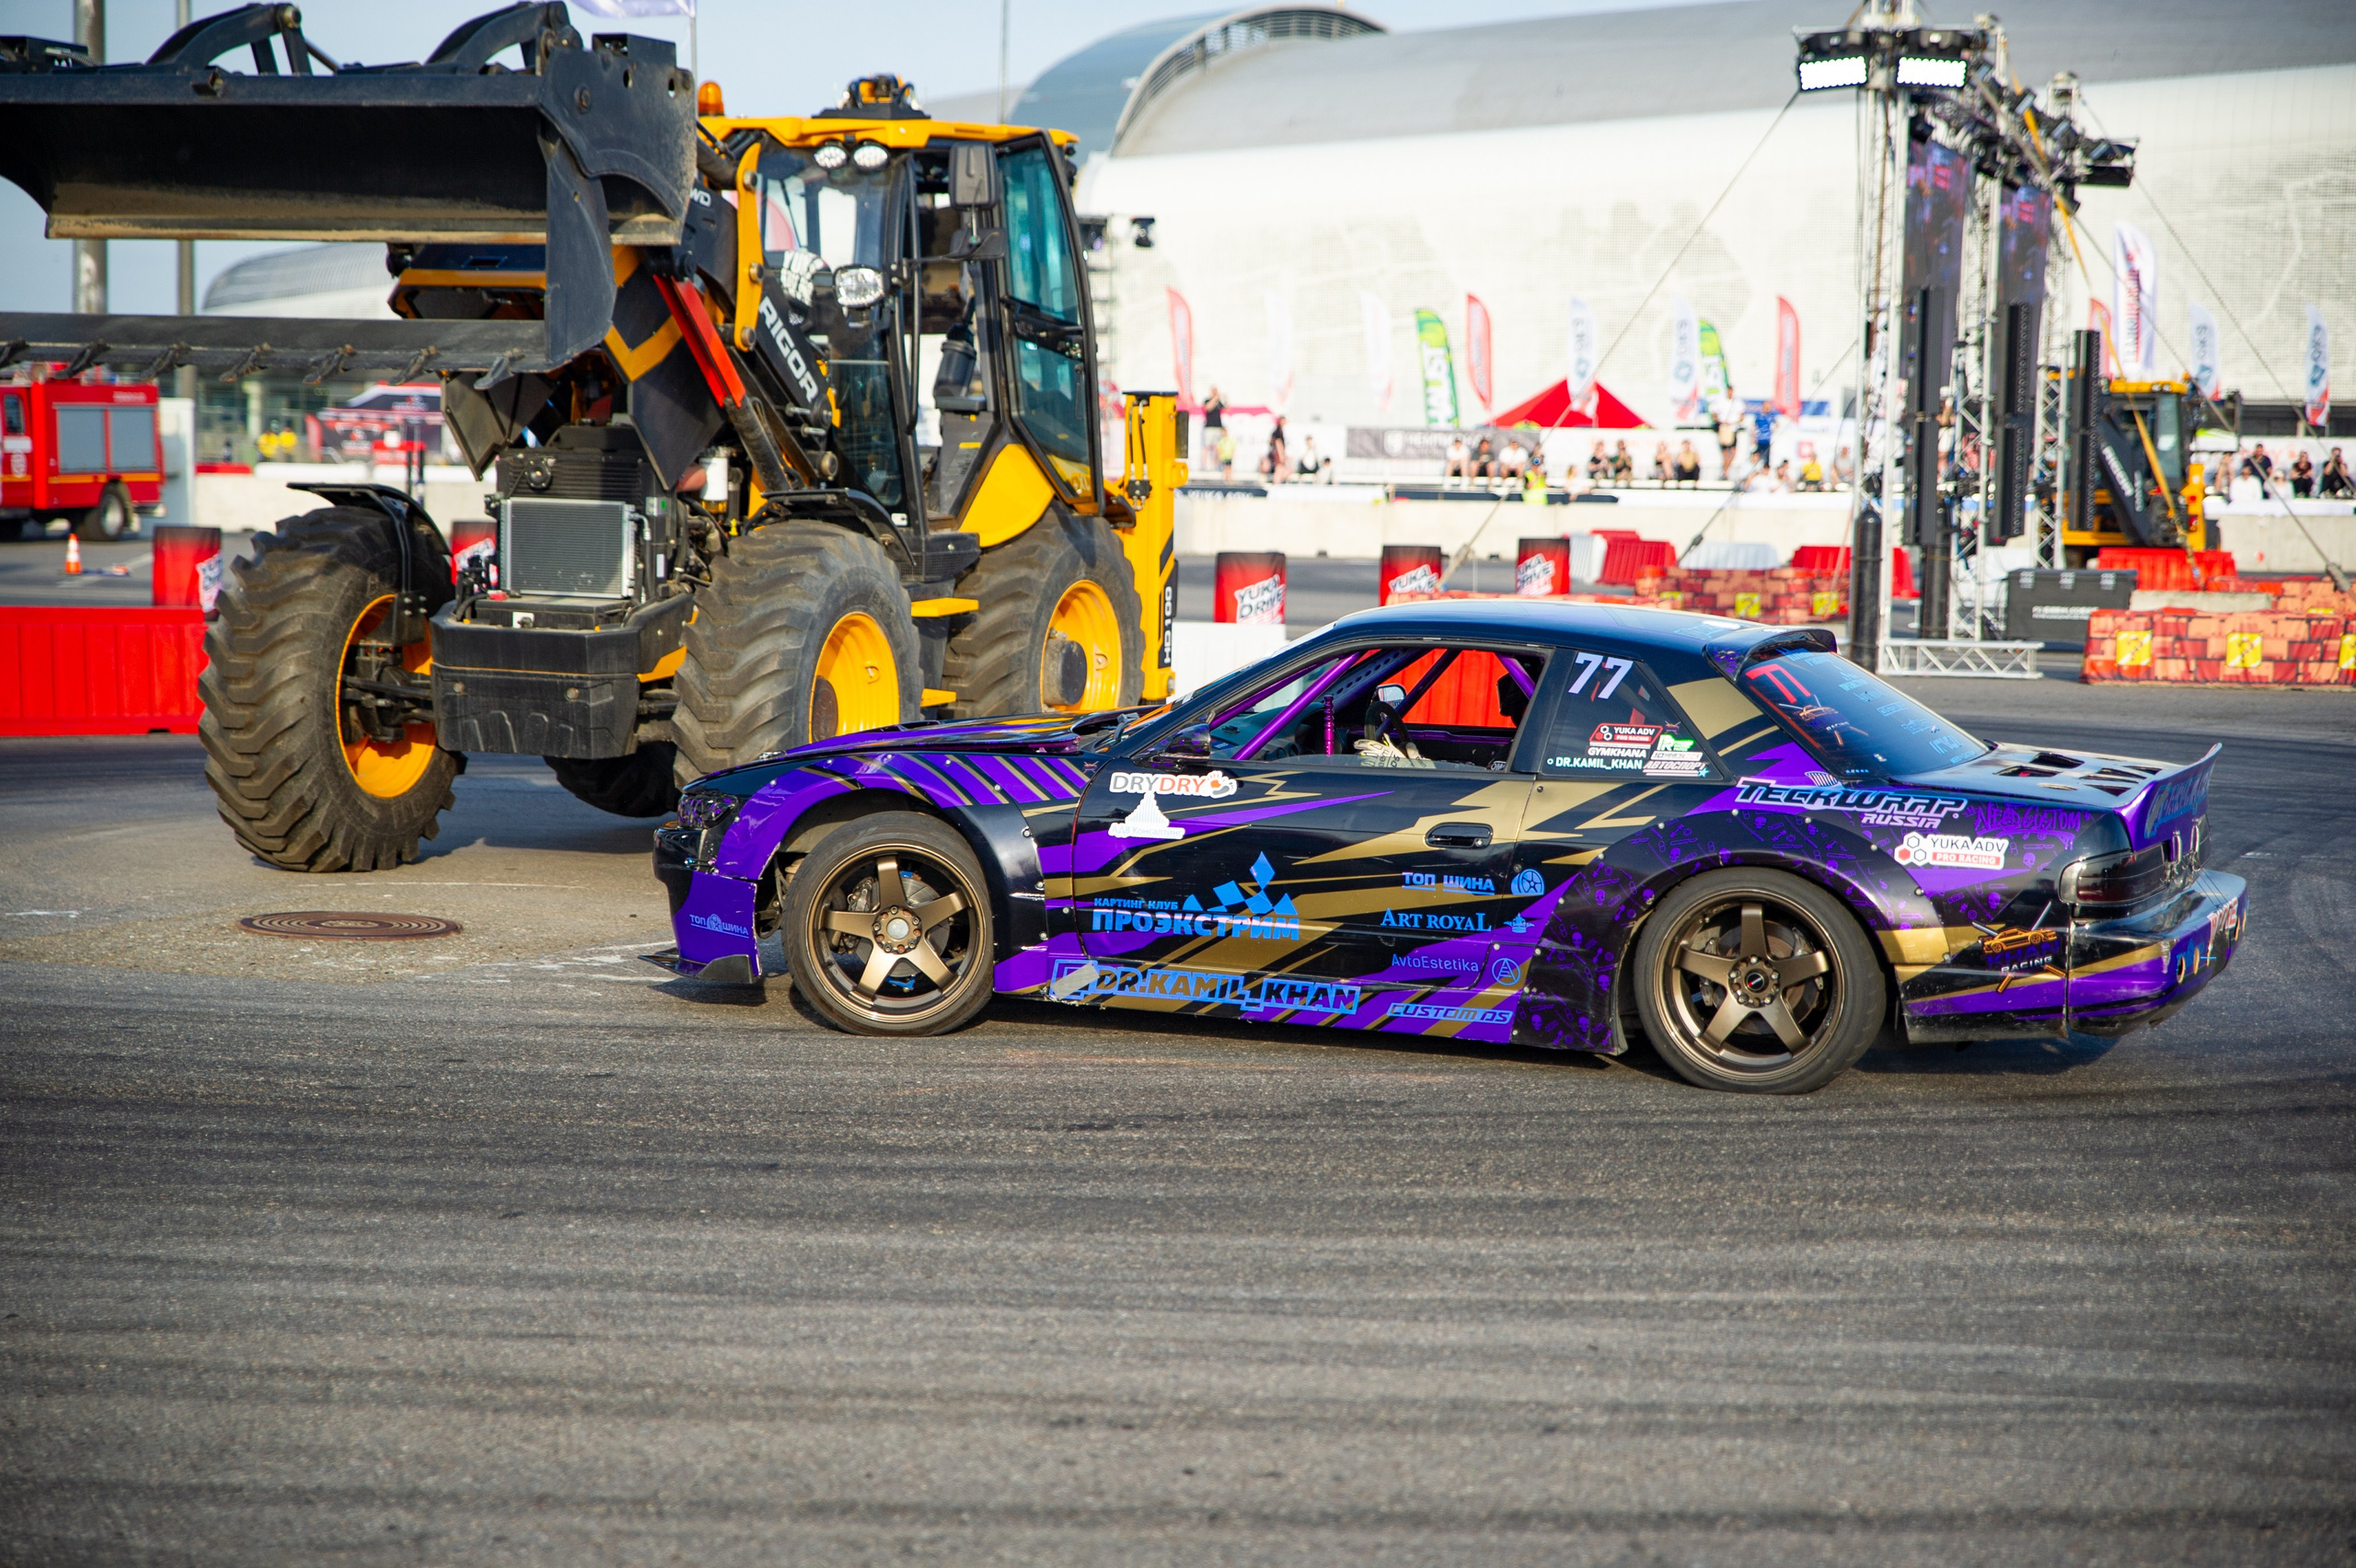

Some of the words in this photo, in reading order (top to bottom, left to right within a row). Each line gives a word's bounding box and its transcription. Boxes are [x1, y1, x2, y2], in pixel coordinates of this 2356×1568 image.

[758, 295, 818, 403] RIGOR
[1239, 577, 1278, 604] YUKA
[1568, 651, 1634, 699] 77
[1613, 726, 1635, 735] YUKA
[1636, 728, 1656, 736] ADV
[1588, 746, 1646, 758] GYMKHANA
[1555, 756, 1643, 770] DR.KAMIL_KHAN
[1113, 774, 1206, 793] DRYDRY
[1861, 813, 1941, 828] RUSSIA
[1931, 837, 1970, 850] YUKA
[1973, 841, 2005, 853] ADV
[1936, 852, 1957, 862] PRO
[1958, 854, 1997, 865] RACING
[1402, 871, 1437, 886] ТОП
[1442, 874, 1496, 892] ШИНА
[1094, 898, 1145, 908] КАРТИНГ
[1148, 901, 1179, 911] КЛУБ
[689, 914, 707, 926] ТОП
[722, 922, 749, 936] ШИНА
[1092, 908, 1299, 941] ПРОЭКСТРИМ
[1380, 907, 1423, 929] ART
[1426, 912, 1492, 932] ROYAL
[1392, 953, 1479, 972] AvtoEstetika
[2001, 955, 2052, 974] RACING
[1391, 1004, 1478, 1020] CUSTOM
